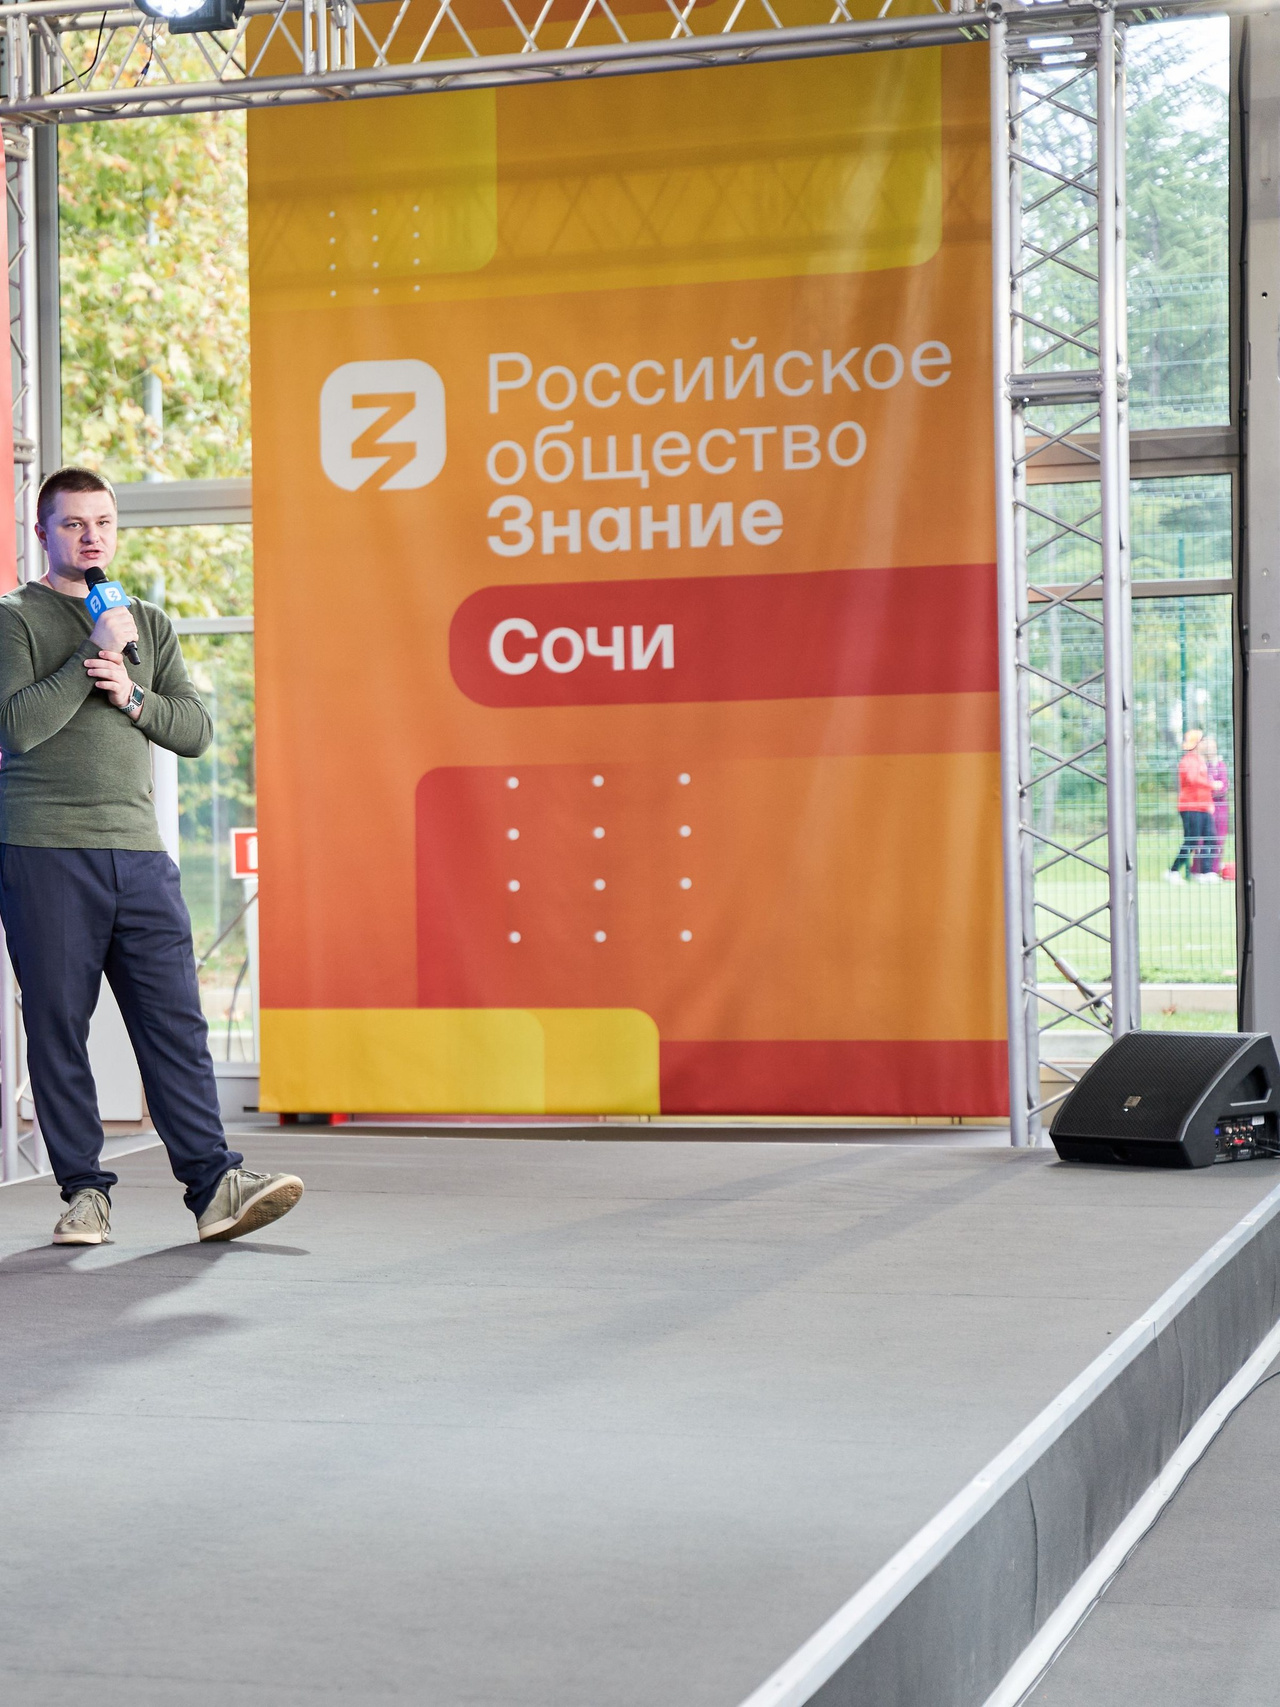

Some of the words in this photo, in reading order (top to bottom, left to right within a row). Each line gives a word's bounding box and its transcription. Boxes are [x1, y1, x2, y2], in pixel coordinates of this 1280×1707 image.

[486, 337, 953, 414] Российское
[486, 420, 868, 489] общество
[486, 494, 784, 557] Знание
[488, 617, 676, 676] Сочи
